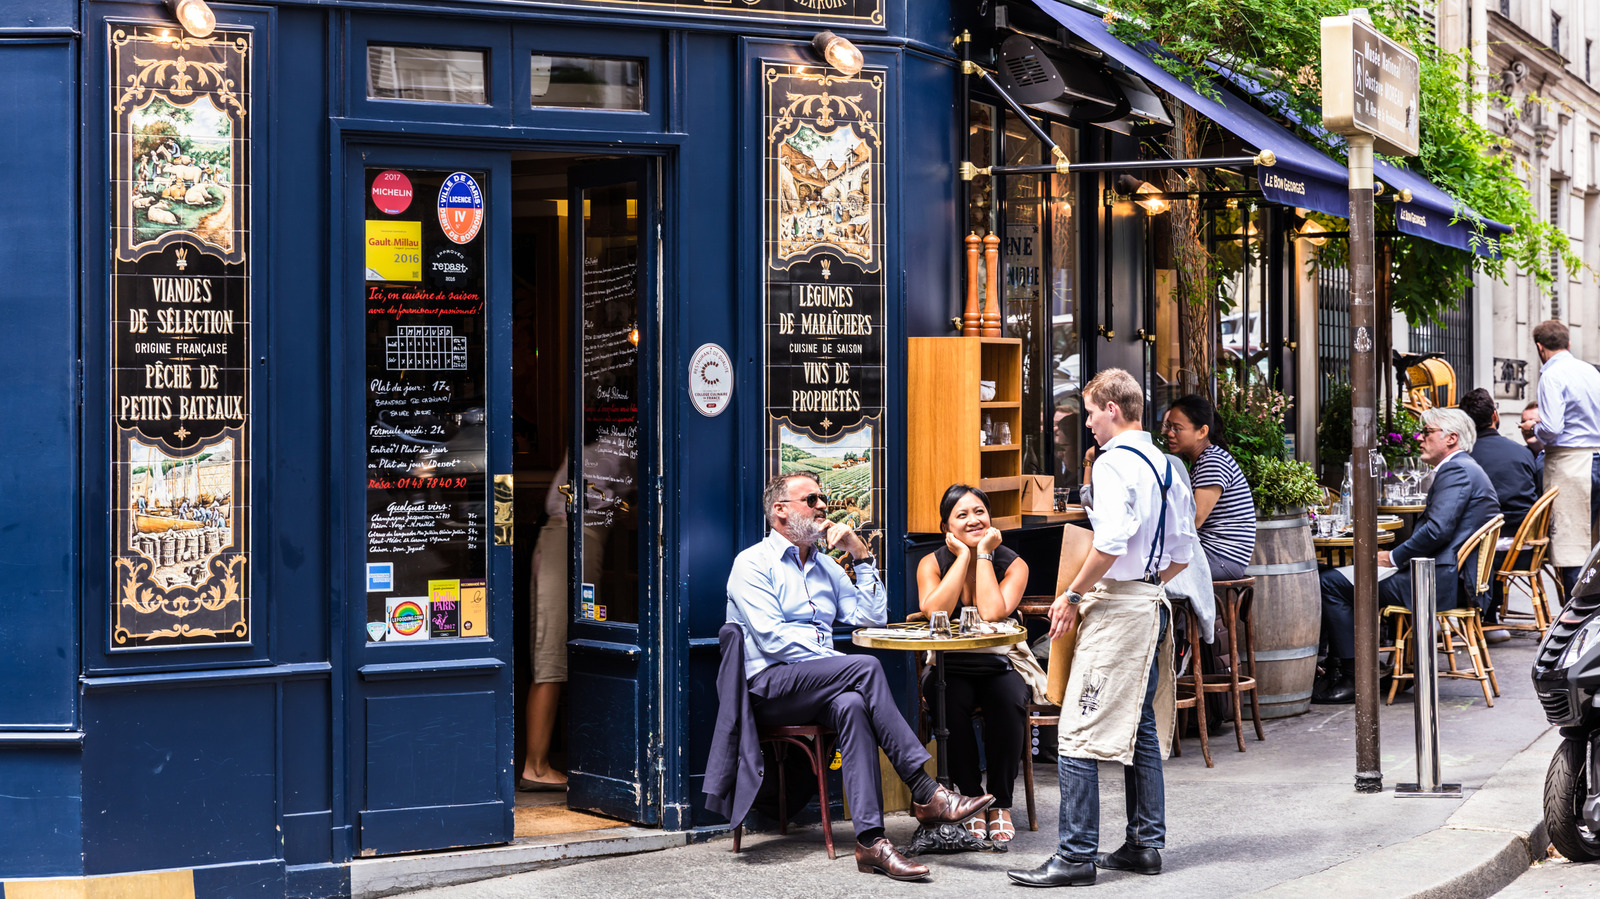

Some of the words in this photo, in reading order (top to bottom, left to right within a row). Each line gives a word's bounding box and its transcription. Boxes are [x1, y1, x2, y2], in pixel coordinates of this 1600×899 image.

[1365, 41, 1380, 66] Musée
[1382, 52, 1400, 79] National
[1365, 70, 1383, 96] Gustave
[1385, 82, 1403, 107] MOREAU
[440, 180, 453, 203] VILLE
[467, 180, 480, 204] PARIS
[1265, 173, 1273, 187] LE
[1274, 175, 1283, 189] BON
[1284, 178, 1305, 195] GEORGES
[372, 188, 412, 197] MICHELIN
[455, 211, 466, 222] IV
[440, 208, 451, 230] DEBIT
[449, 232, 458, 241] DE
[460, 210, 481, 242] BOISSONS
[394, 254, 419, 263] 2016
[437, 250, 464, 259] APPROVED
[152, 278, 212, 303] VIANDES
[369, 287, 386, 303] Ici,
[402, 286, 434, 300] cuisine
[436, 291, 446, 300] de
[448, 291, 480, 300] saison
[799, 284, 853, 307] LÉGUMES
[130, 309, 149, 333] DE
[157, 307, 234, 334] SÉLECTION
[779, 313, 795, 334] DE
[801, 310, 872, 335] MARAÎCHERS
[135, 343, 171, 354] ORIGINE
[177, 343, 227, 357] FRANÇAISE
[790, 343, 817, 353] CUISINE
[823, 344, 832, 353] DE
[837, 344, 862, 354] SAISON
[694, 351, 712, 374] RESTAURANT
[145, 360, 192, 389] PÊCHE
[200, 365, 219, 389] DE
[803, 362, 829, 384] VINS
[835, 363, 850, 384] DE
[371, 379, 391, 392] Plat
[392, 382, 402, 391] du
[120, 396, 172, 420] PETITS
[179, 396, 243, 420] BATEAUX
[792, 388, 860, 412] PROPRIÉTÉS
[370, 425, 401, 435] Formule
[430, 445, 448, 456] jour
[379, 459, 398, 468] Plat
[406, 460, 425, 472] jour
[368, 478, 395, 489] Résa:
[397, 478, 410, 488] 01
[412, 478, 424, 488] 48
[426, 478, 438, 488] 78
[439, 478, 452, 488] 40
[453, 477, 467, 488] 30
[387, 500, 424, 516] Quelques
[371, 514, 405, 524] Champagne
[433, 591, 455, 601] Pudlo
[433, 601, 456, 611] PARIS
